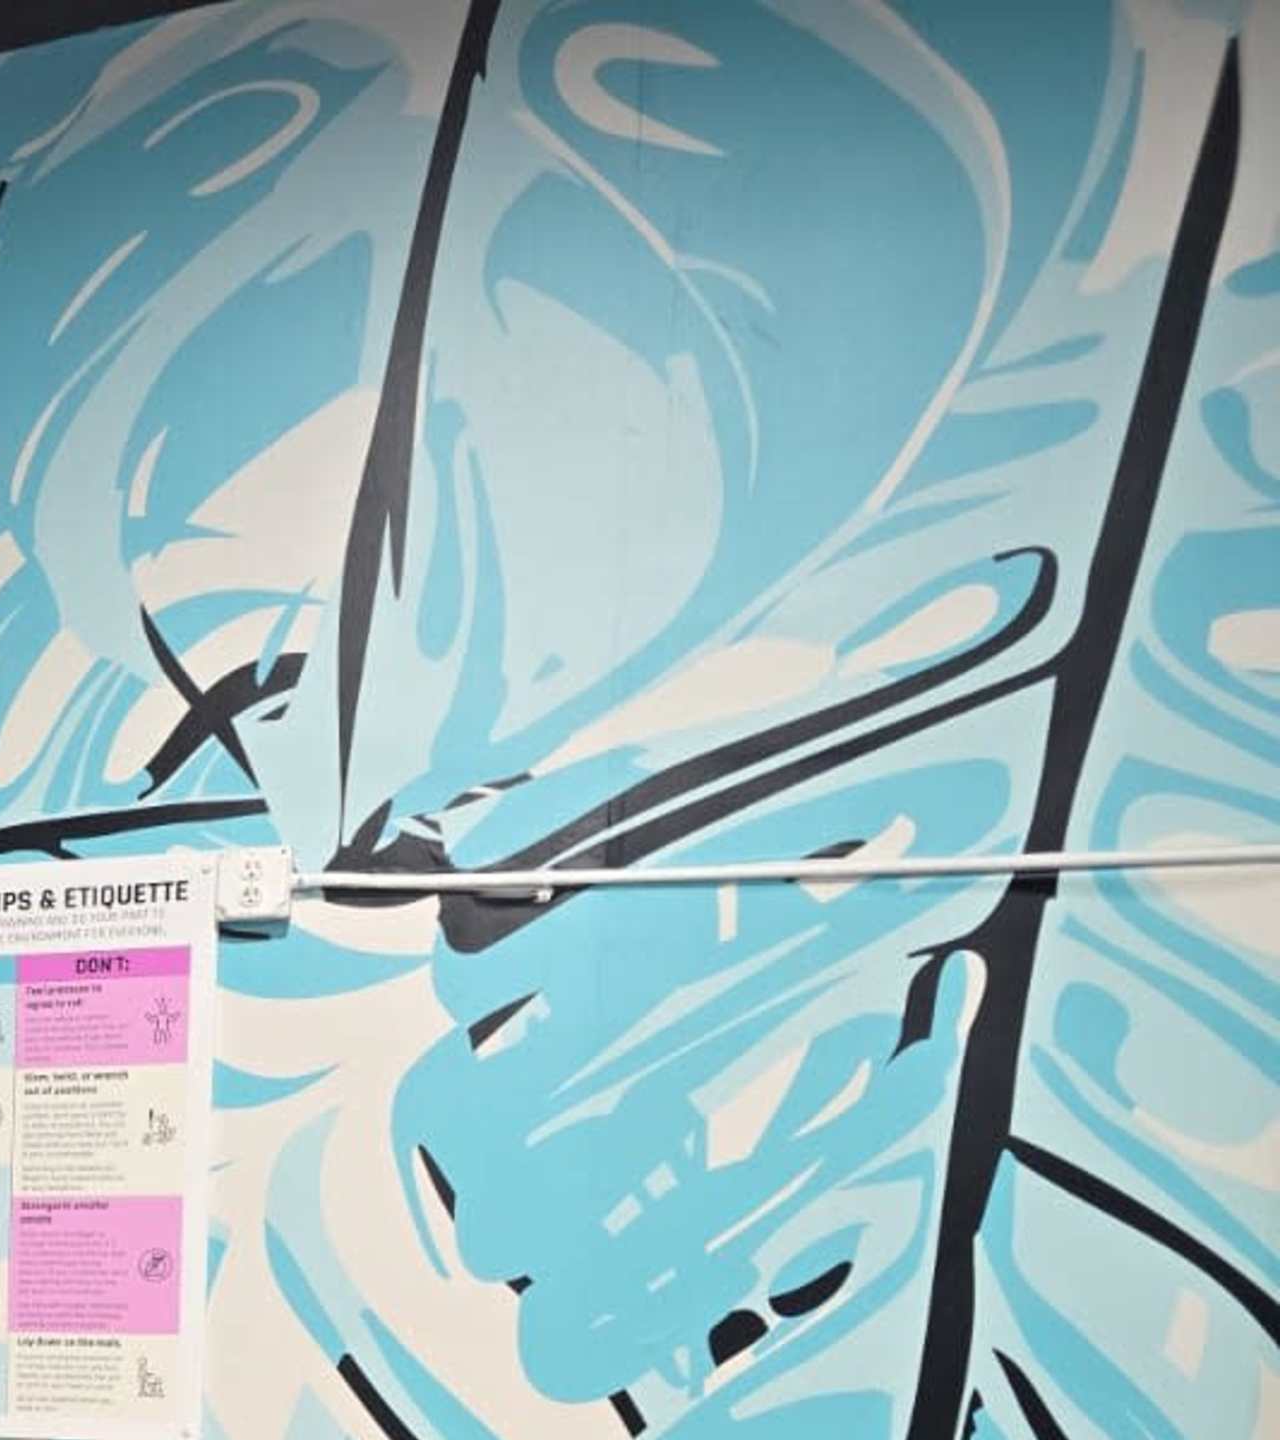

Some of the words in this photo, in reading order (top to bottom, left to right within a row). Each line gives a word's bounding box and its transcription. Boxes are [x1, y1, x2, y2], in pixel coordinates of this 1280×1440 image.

[40, 889, 56, 909] &
[64, 880, 189, 909] ETIQUETTE
[75, 956, 130, 974] DON'T:
